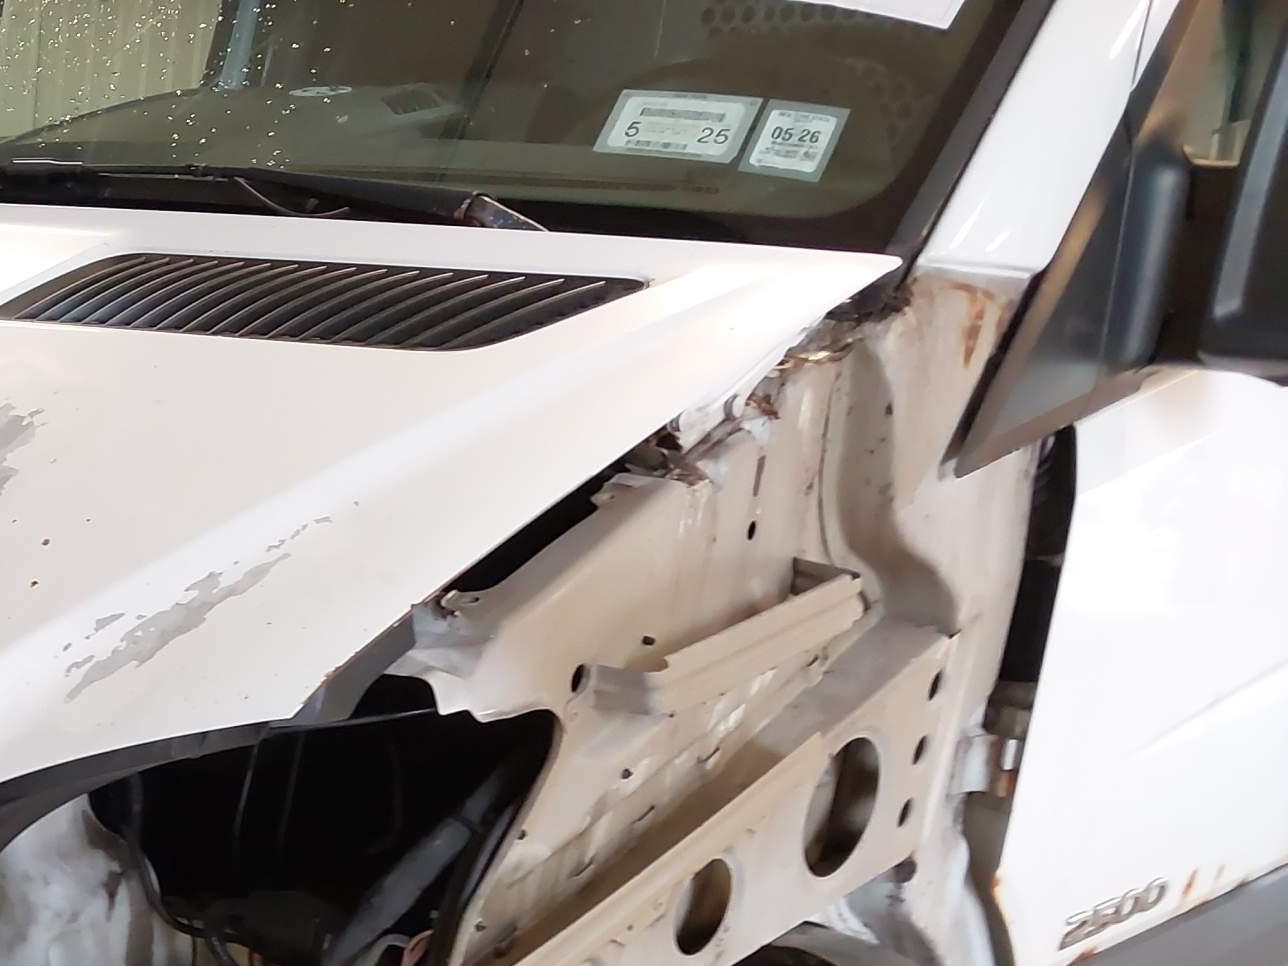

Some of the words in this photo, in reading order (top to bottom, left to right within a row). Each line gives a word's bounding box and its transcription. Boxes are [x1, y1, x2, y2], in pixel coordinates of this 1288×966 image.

[624, 121, 642, 137] 5
[697, 127, 730, 144] 25
[771, 126, 794, 142] 05
[798, 128, 821, 144] 26
[1059, 876, 1169, 951] 2500
